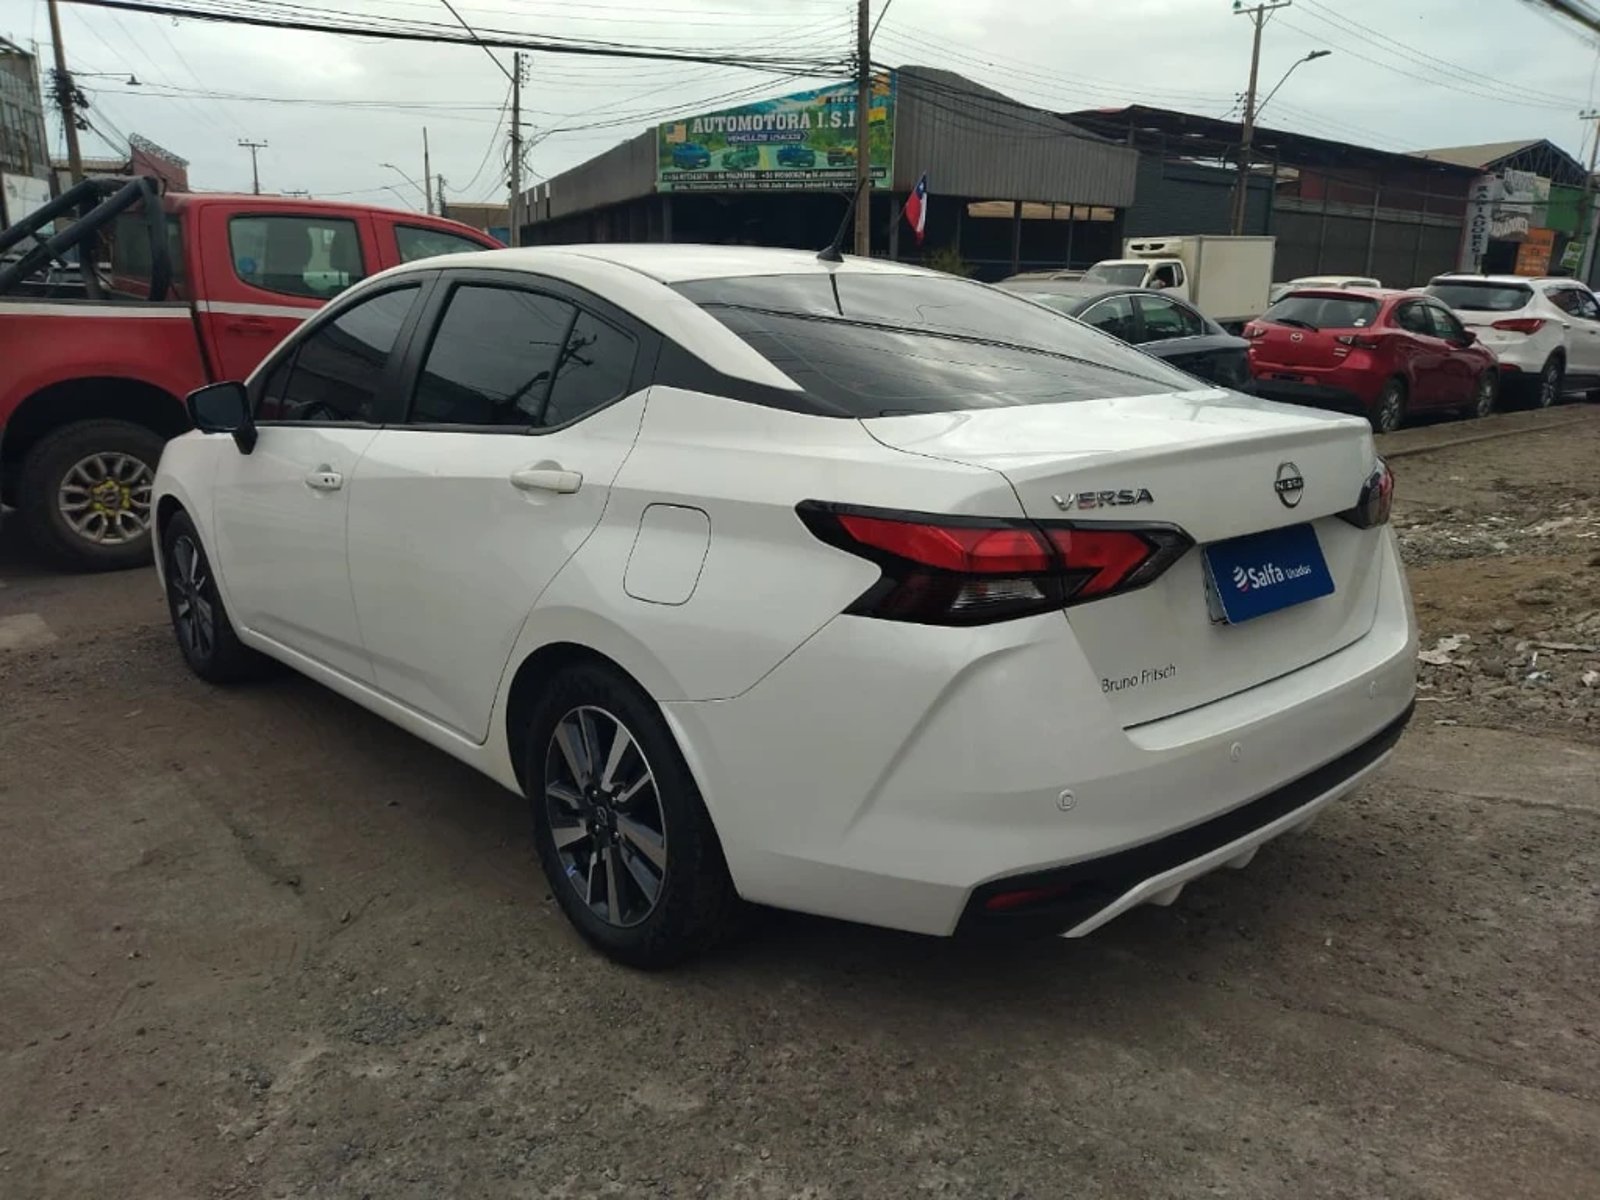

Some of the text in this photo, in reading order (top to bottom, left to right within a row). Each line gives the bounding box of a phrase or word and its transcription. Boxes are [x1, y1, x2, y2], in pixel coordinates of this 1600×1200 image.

[692, 111, 855, 133] AUTOMOTORA I.S.I
[1051, 488, 1154, 511] VERSA
[1247, 562, 1285, 589] Salfa
[1101, 663, 1176, 693] Bruno Fritsch
